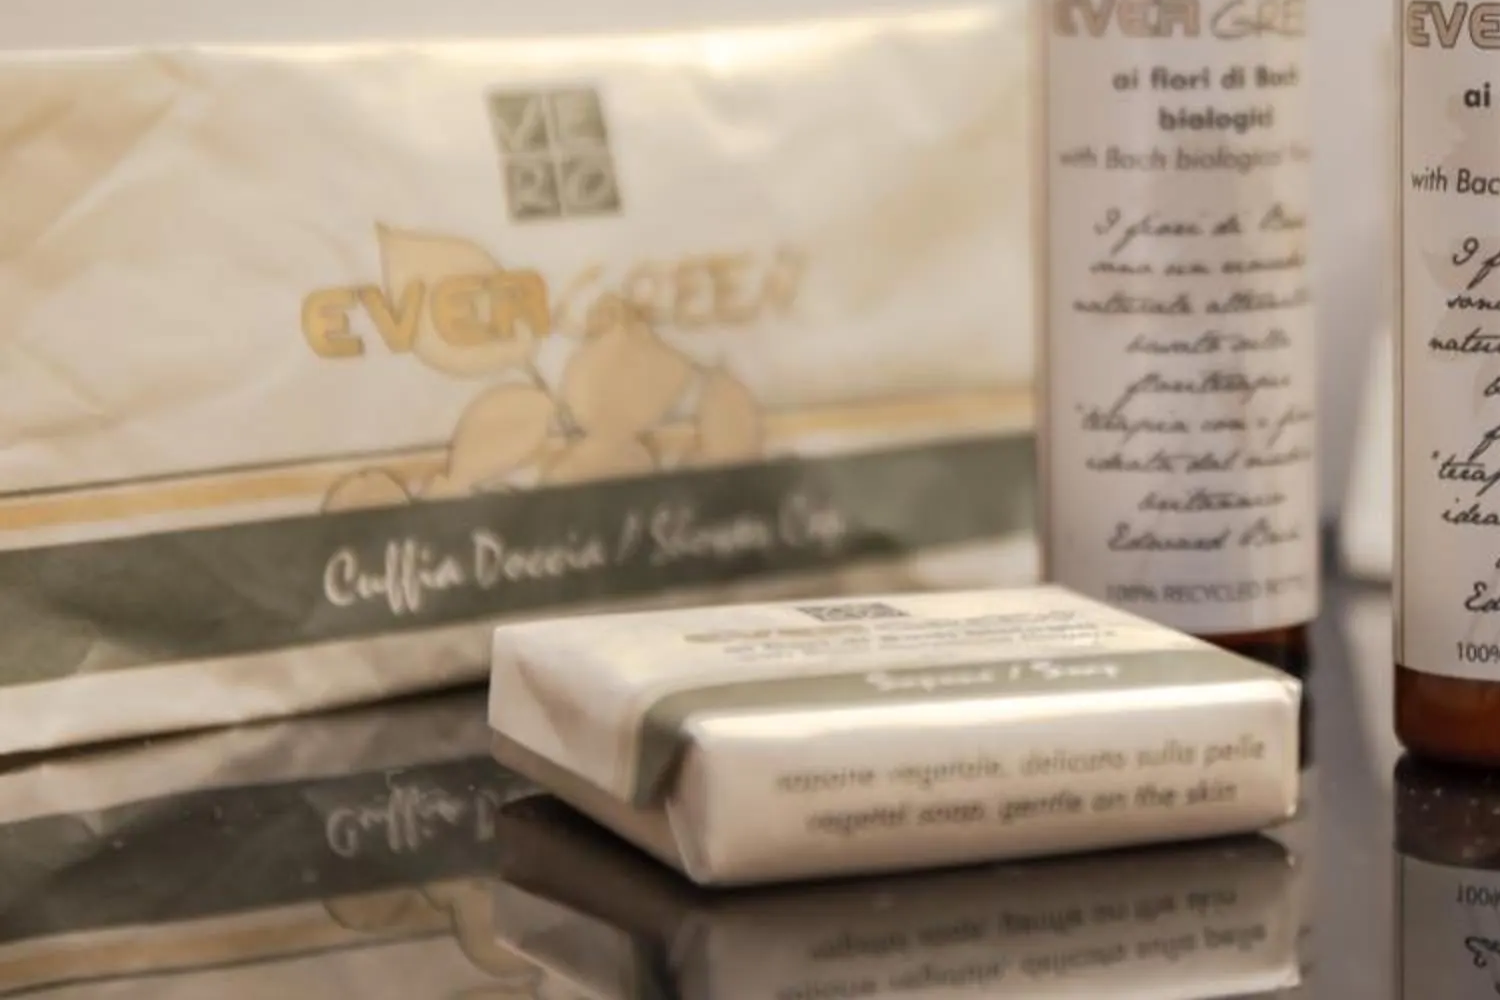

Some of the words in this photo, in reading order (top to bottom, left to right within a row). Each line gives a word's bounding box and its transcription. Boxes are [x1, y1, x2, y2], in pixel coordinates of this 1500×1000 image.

[1220, 66, 1245, 90] di
[1463, 82, 1491, 109] ai
[1411, 166, 1448, 193] with
[301, 269, 552, 358] EVER
[324, 537, 464, 617] Cuffia
